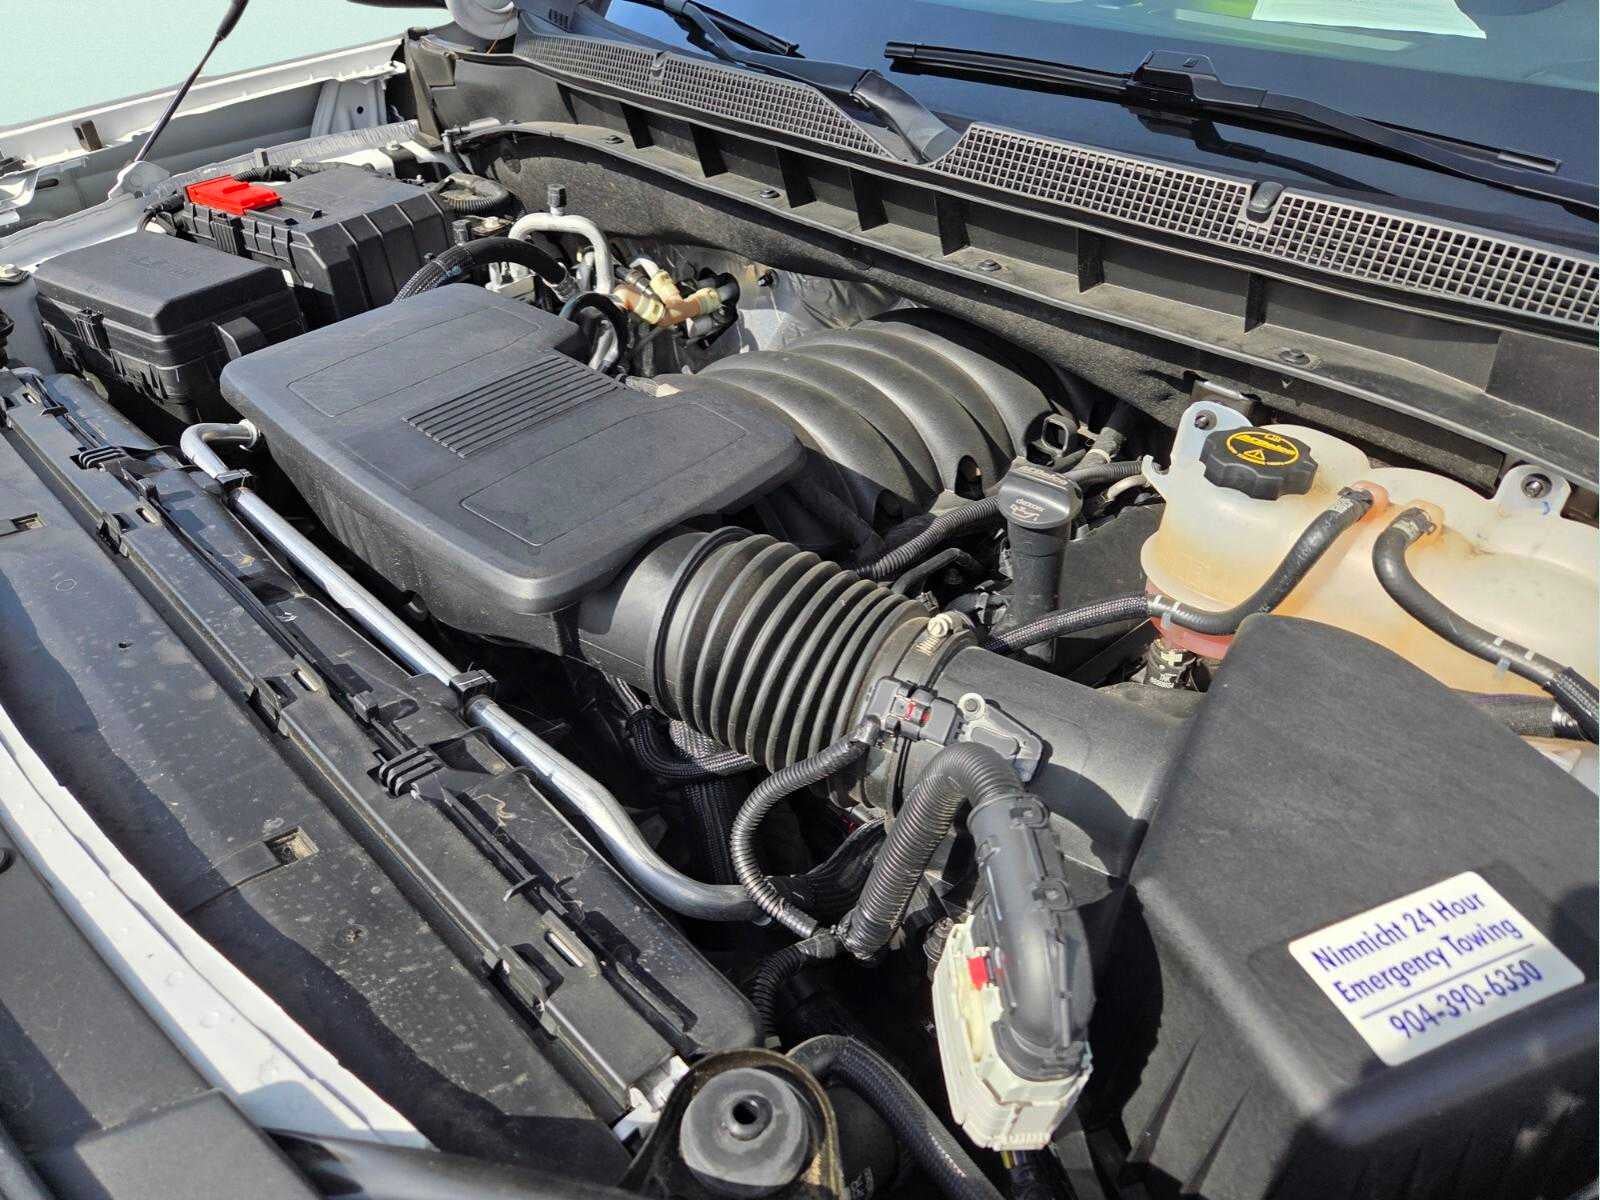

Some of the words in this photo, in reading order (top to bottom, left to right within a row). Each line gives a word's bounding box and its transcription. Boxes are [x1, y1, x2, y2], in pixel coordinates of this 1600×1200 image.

[1312, 922, 1407, 971] Nimnicht
[1403, 908, 1435, 932] 24
[1431, 893, 1485, 921] Hour
[1334, 947, 1451, 1003] Emergency
[1442, 919, 1523, 955] Towing
[1389, 960, 1542, 1039] 904-390-6350
